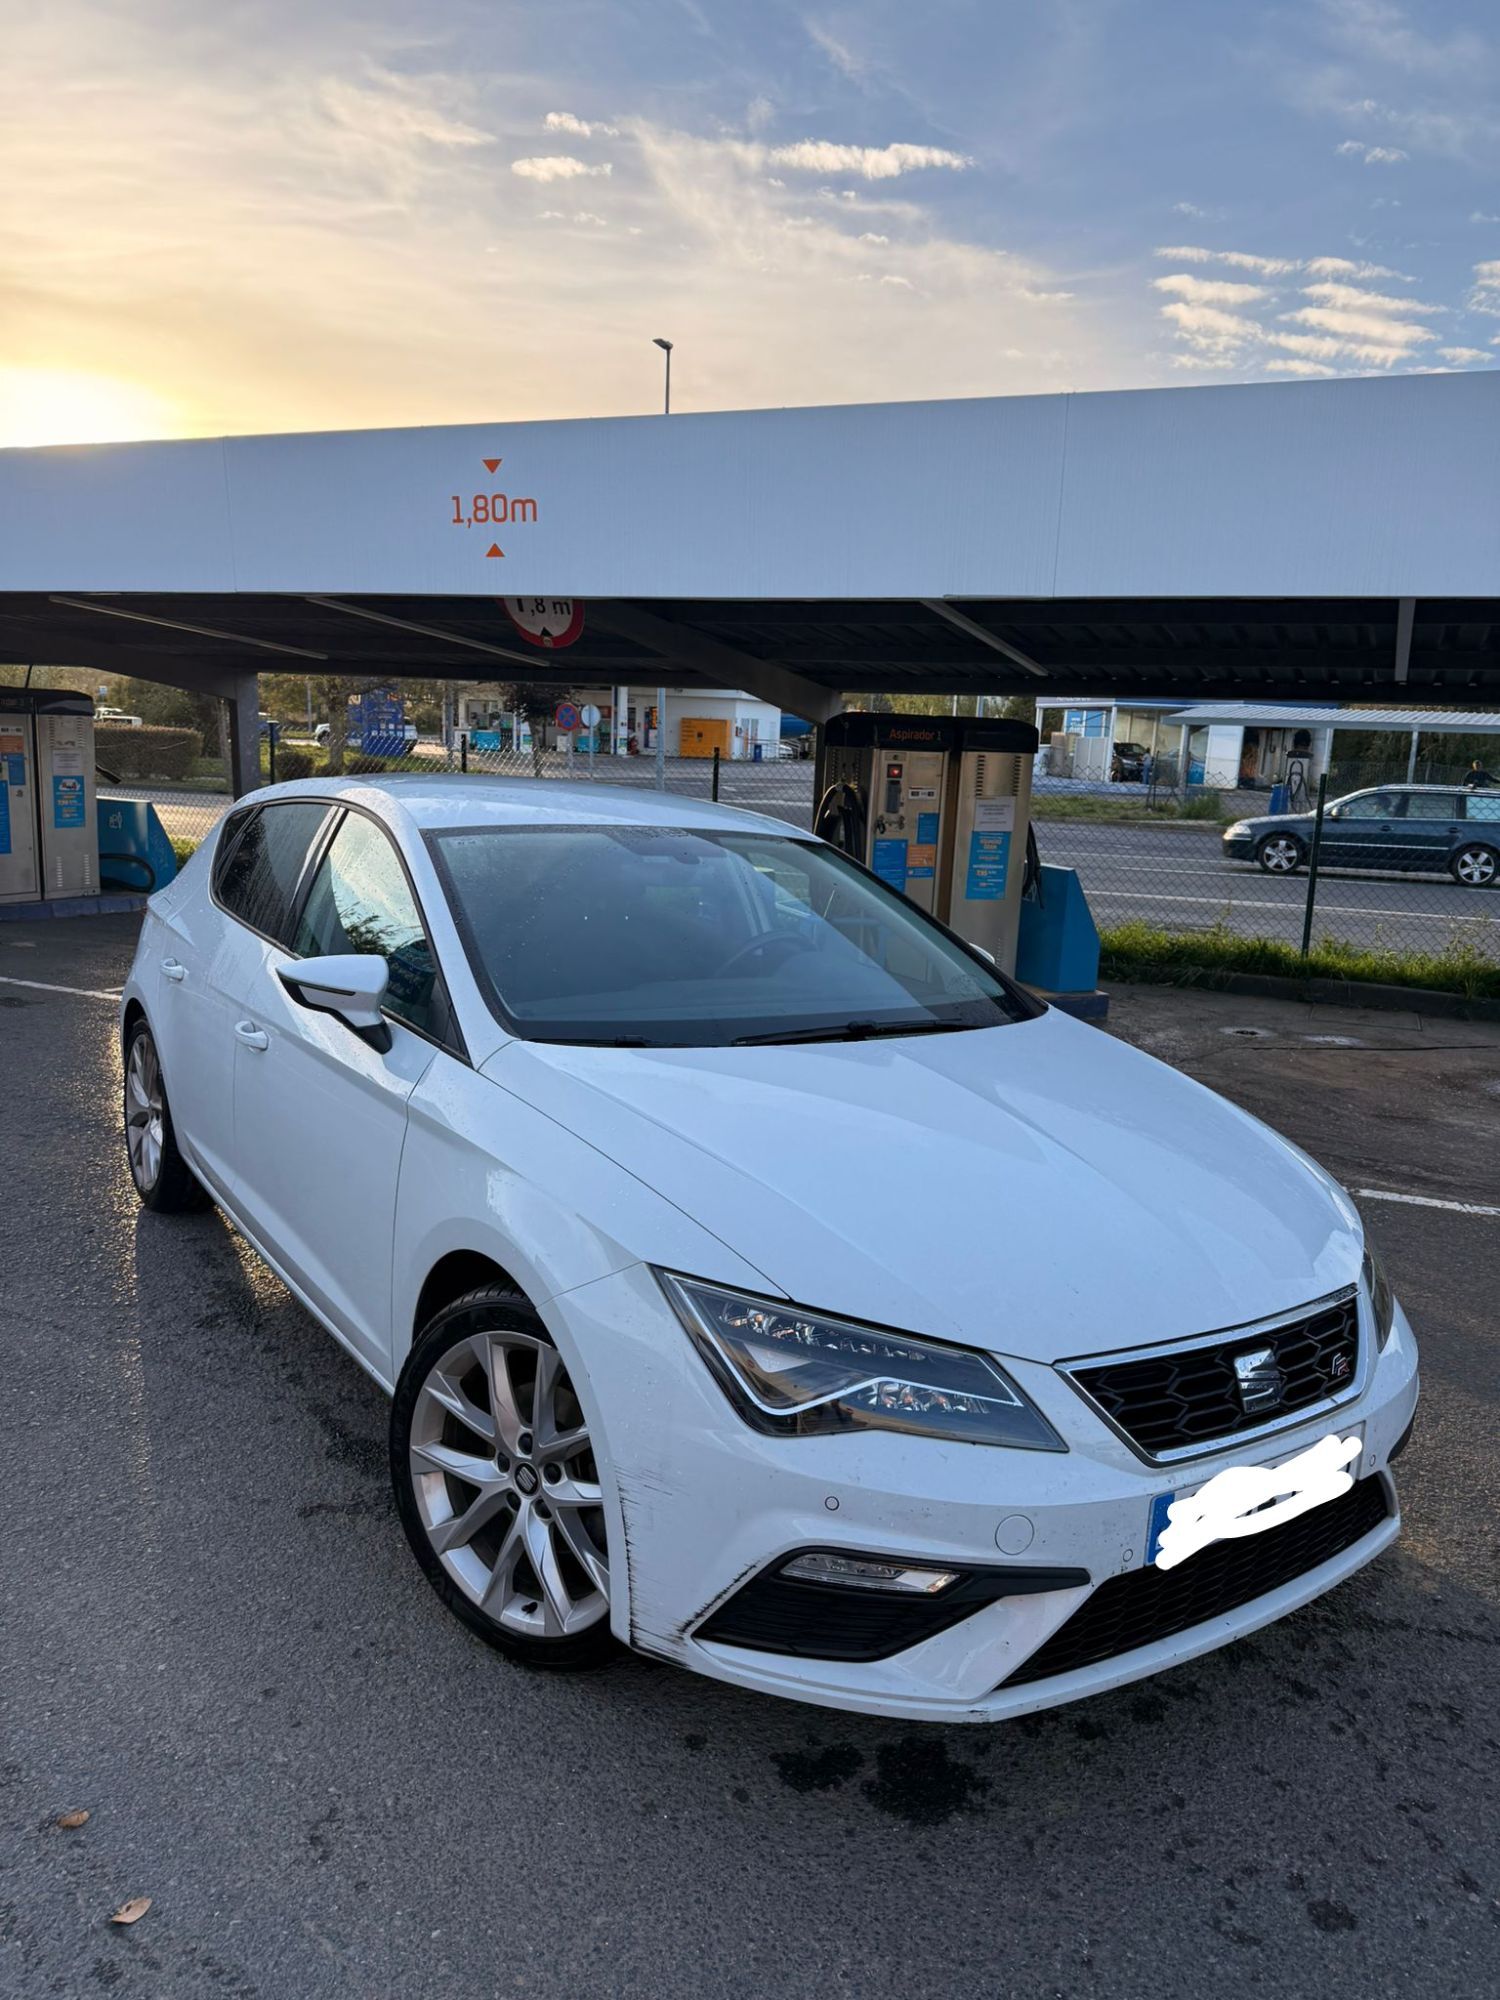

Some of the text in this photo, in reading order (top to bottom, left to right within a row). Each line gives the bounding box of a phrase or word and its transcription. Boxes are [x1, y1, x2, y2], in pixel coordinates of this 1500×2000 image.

[452, 493, 537, 528] 1,80m
[889, 728, 935, 741] Aspirador
[1331, 1352, 1350, 1376] FR
